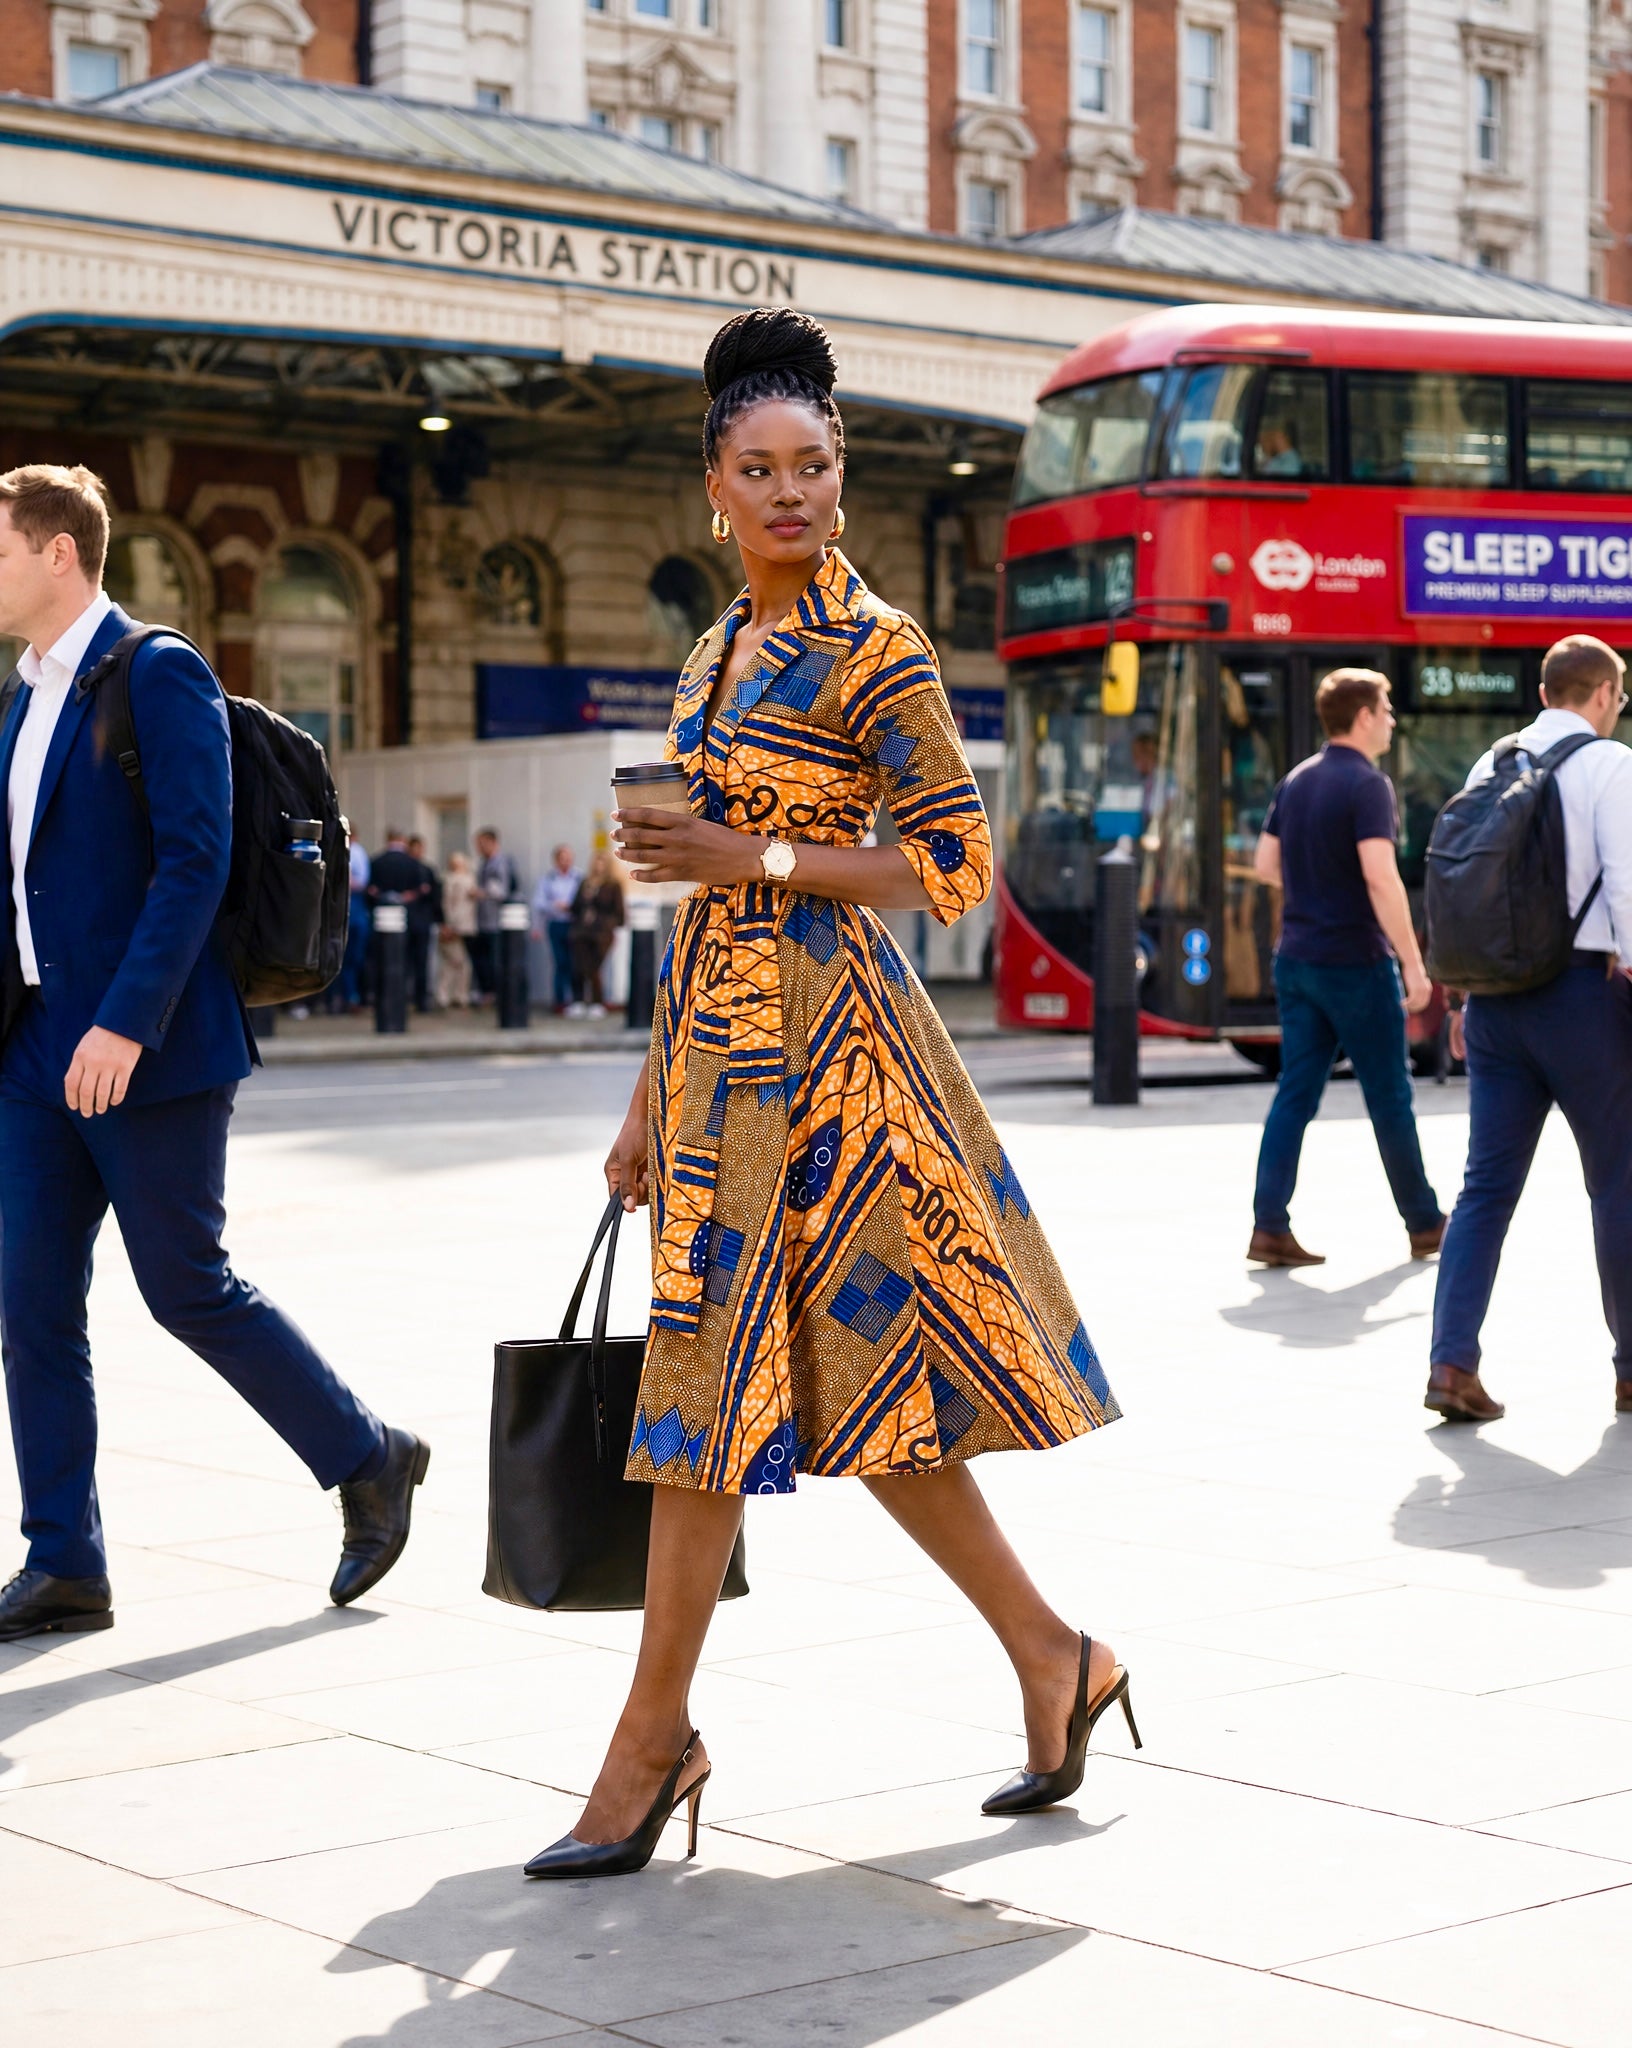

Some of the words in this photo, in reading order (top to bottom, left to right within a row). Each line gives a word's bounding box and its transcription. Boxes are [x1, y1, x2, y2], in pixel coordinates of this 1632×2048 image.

[333, 201, 577, 273] VICTORIA
[602, 239, 796, 300] STATION
[1314, 552, 1386, 578] London
[1424, 530, 1554, 577] SLEEP
[1559, 535, 1632, 580] TIG
[1425, 581, 1500, 601] PREMIUM
[1502, 582, 1549, 602] SLEEP
[1454, 671, 1515, 693] Victoria
